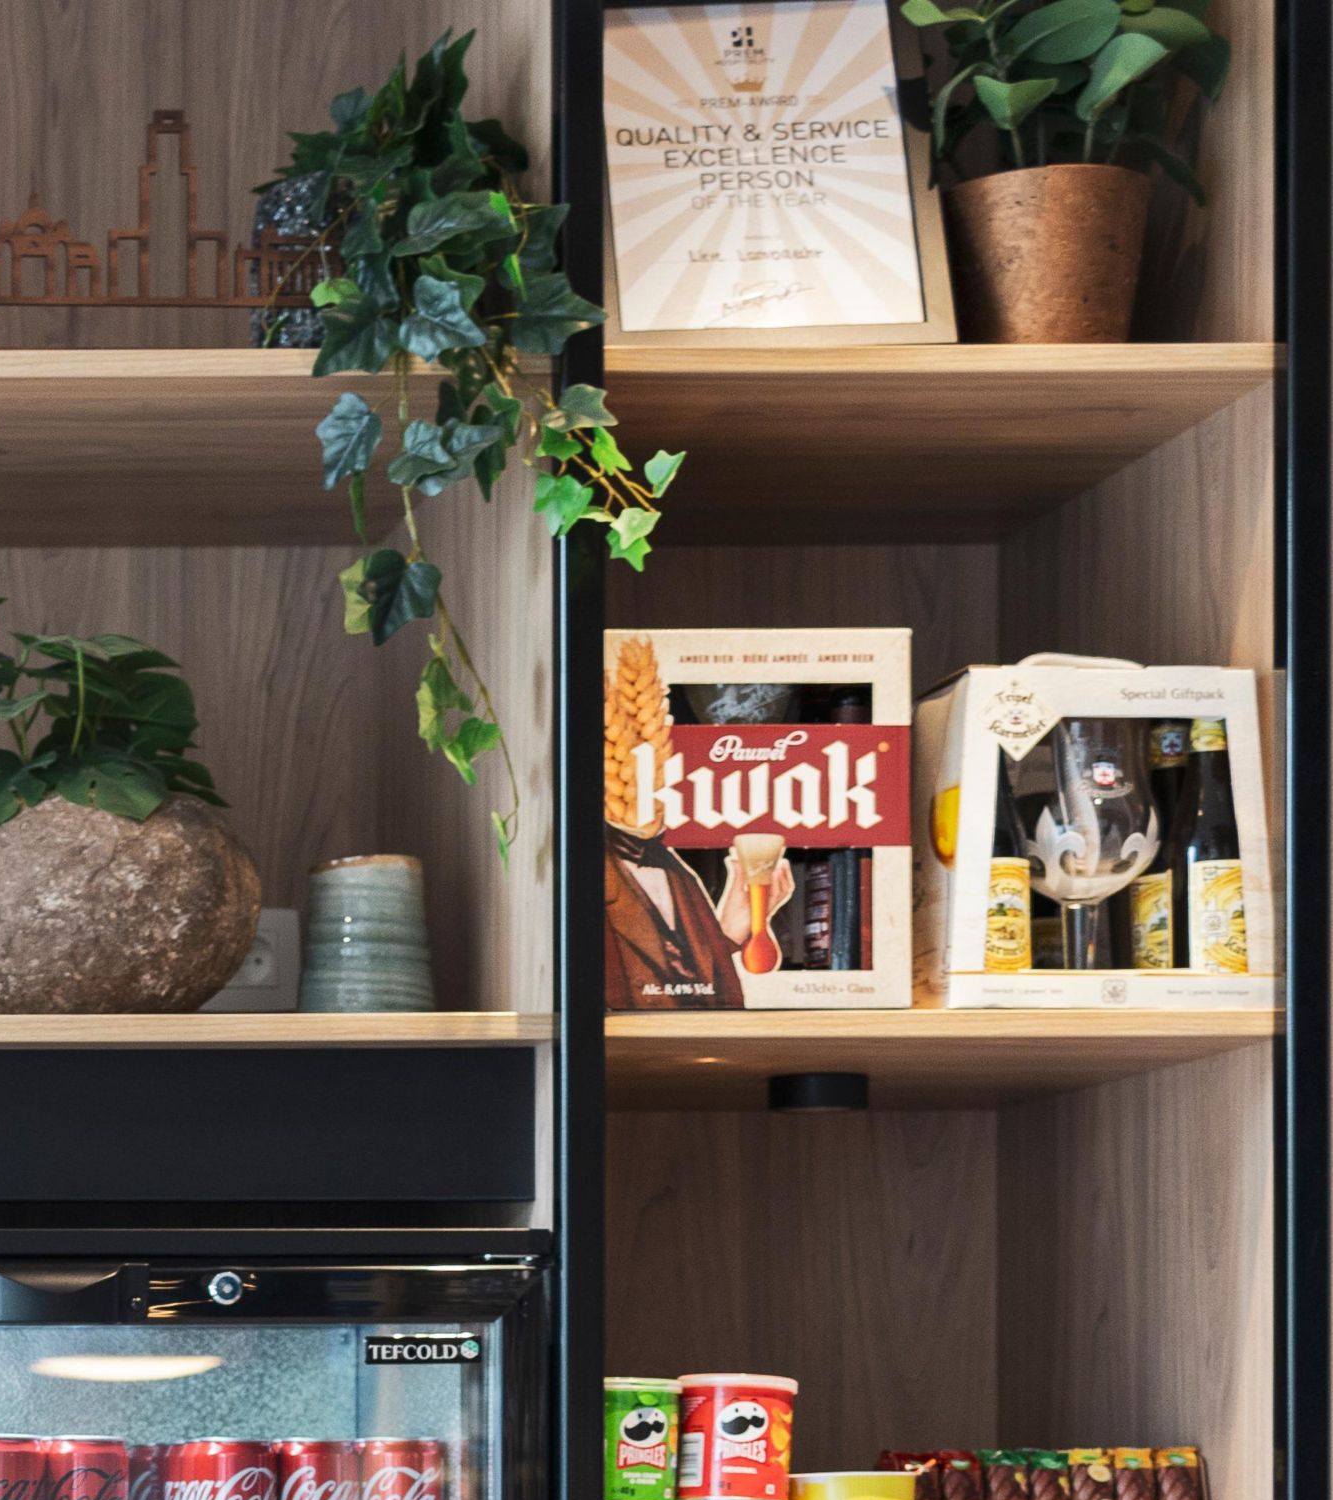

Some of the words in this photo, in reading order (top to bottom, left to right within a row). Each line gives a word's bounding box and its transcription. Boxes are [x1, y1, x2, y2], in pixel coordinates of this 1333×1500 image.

[616, 124, 732, 146] QUALITY
[744, 123, 762, 142] &
[774, 119, 890, 141] SERVICE
[665, 144, 846, 169] EXCELLENCE
[700, 171, 815, 191] PERSON
[774, 192, 828, 207] YEAR
[1120, 687, 1167, 700] Special
[1171, 688, 1226, 700] Giftpack
[368, 1344, 459, 1360] TEFCOLD
